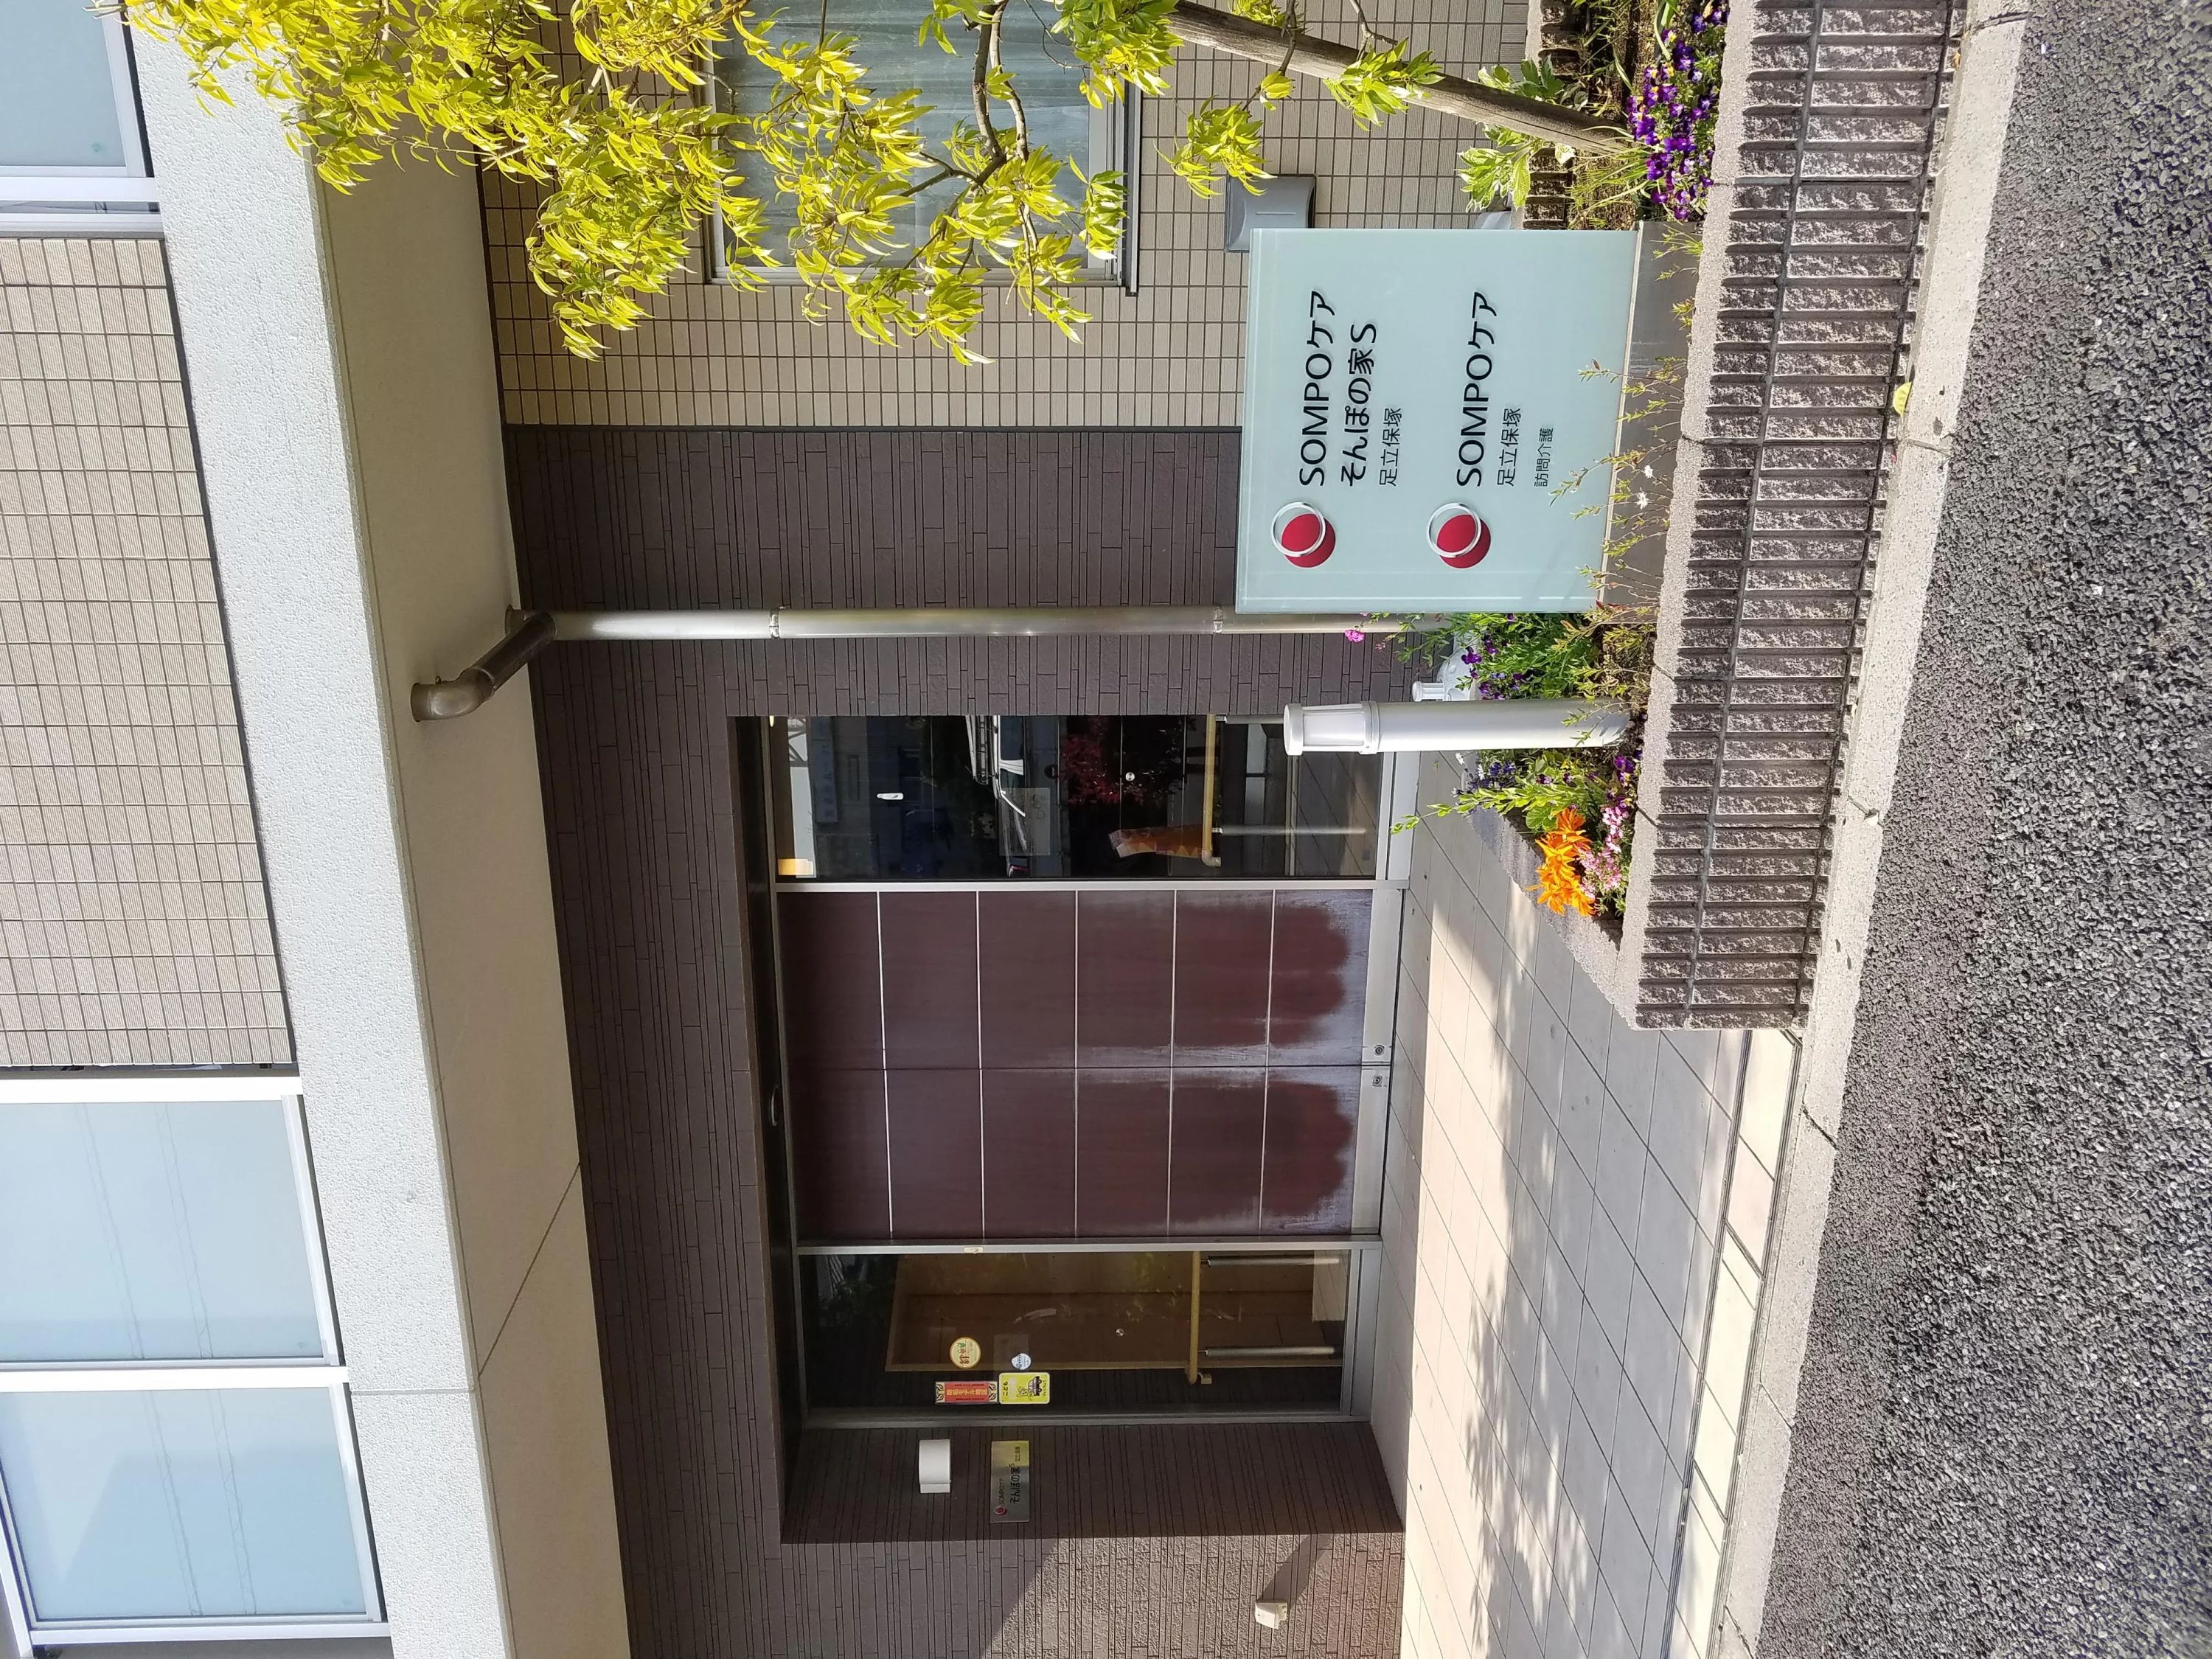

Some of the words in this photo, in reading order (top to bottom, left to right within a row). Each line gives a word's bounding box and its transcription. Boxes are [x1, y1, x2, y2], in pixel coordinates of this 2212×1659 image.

[1299, 291, 1335, 486] SOMPOケア
[1341, 324, 1376, 486] そんぽの家S
[1380, 408, 1402, 486] 足立保塚
[1457, 292, 1496, 487] SOMPOケア
[1498, 408, 1520, 486] 足立保塚
[1534, 428, 1553, 487] 訪問介護
